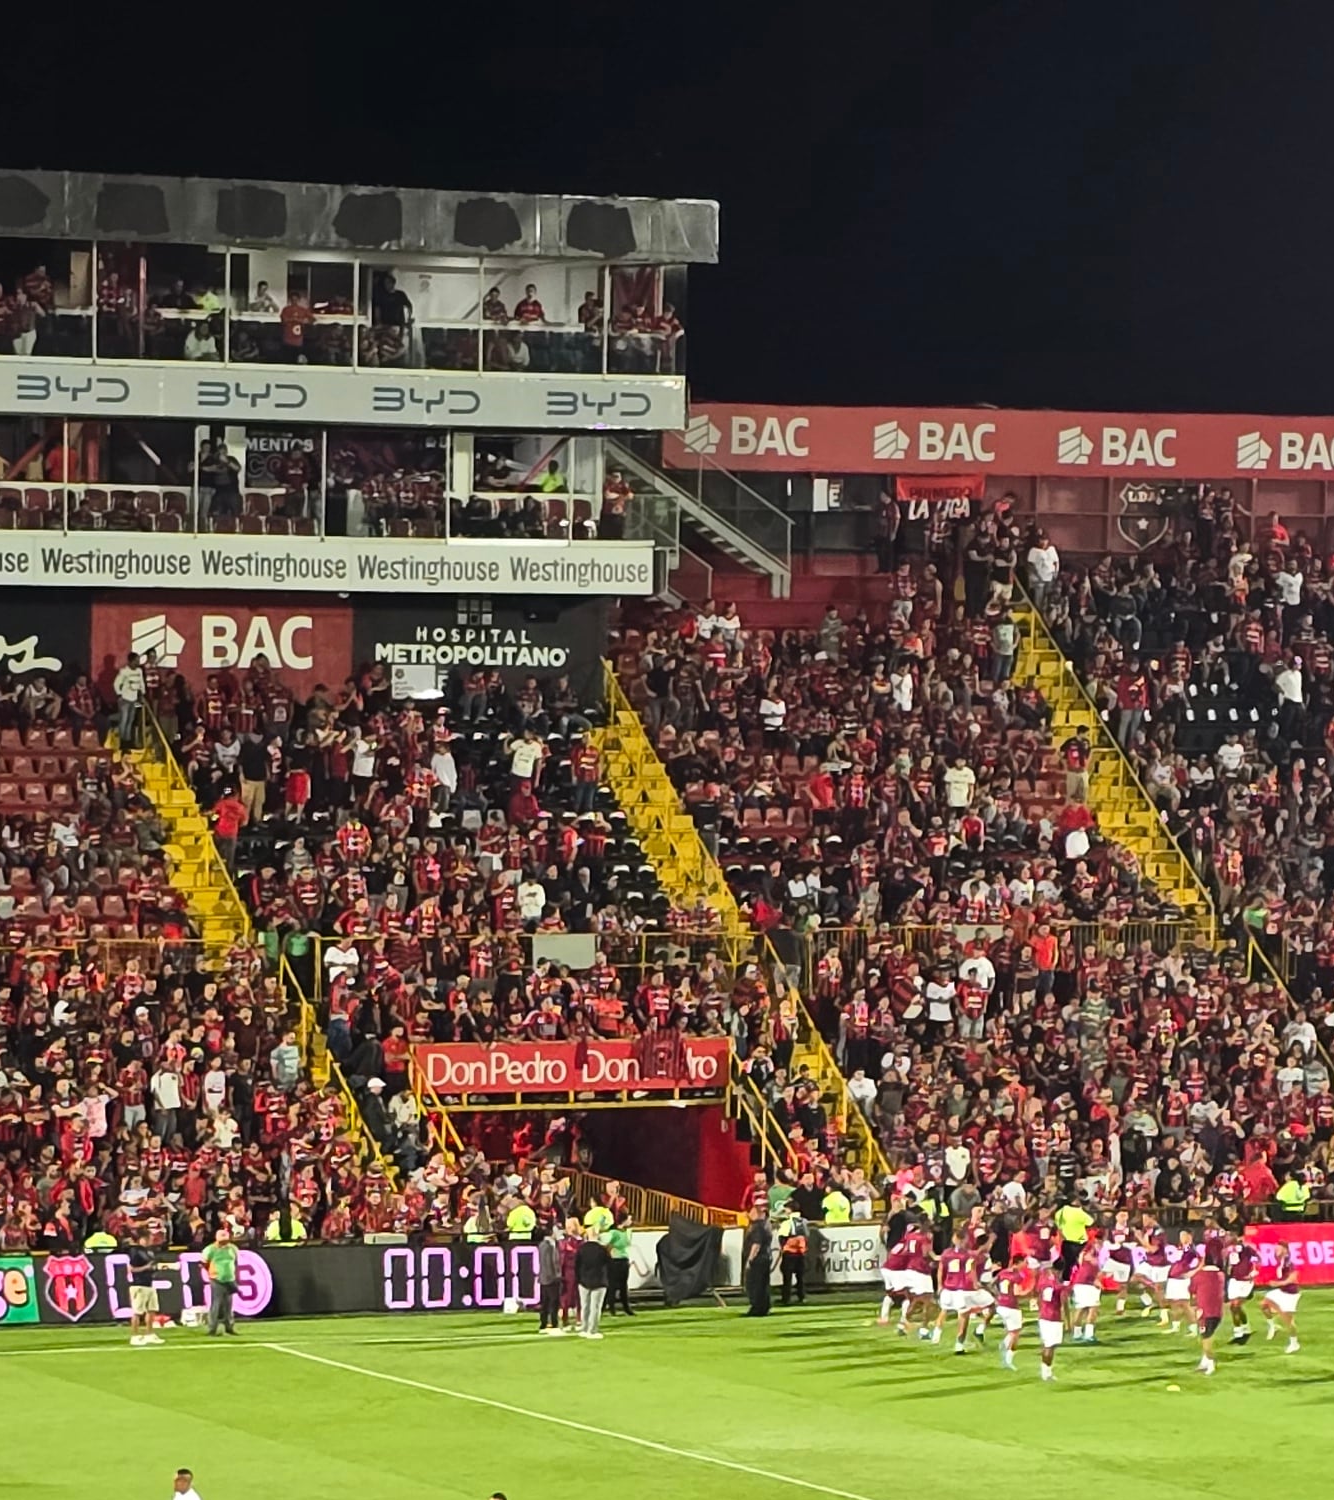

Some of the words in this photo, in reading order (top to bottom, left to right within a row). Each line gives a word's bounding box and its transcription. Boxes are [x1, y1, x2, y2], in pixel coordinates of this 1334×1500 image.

[16, 374, 131, 403] BYD
[197, 381, 308, 409] BYD
[373, 387, 481, 415] BYD
[546, 391, 652, 417] BYD
[730, 415, 810, 457] BAC
[918, 421, 996, 462] BAC
[1100, 427, 1177, 467] BAC
[41, 547, 192, 581] Westinghouse
[201, 549, 347, 583] Westinghouse
[357, 553, 500, 586] Westinghouse
[510, 555, 650, 588] Westinghouse
[201, 614, 314, 670] BAC
[374, 642, 569, 668] METROPOLITANO
[416, 625, 532, 645] HOSPITAL
[383, 1246, 541, 1309] 00:00
